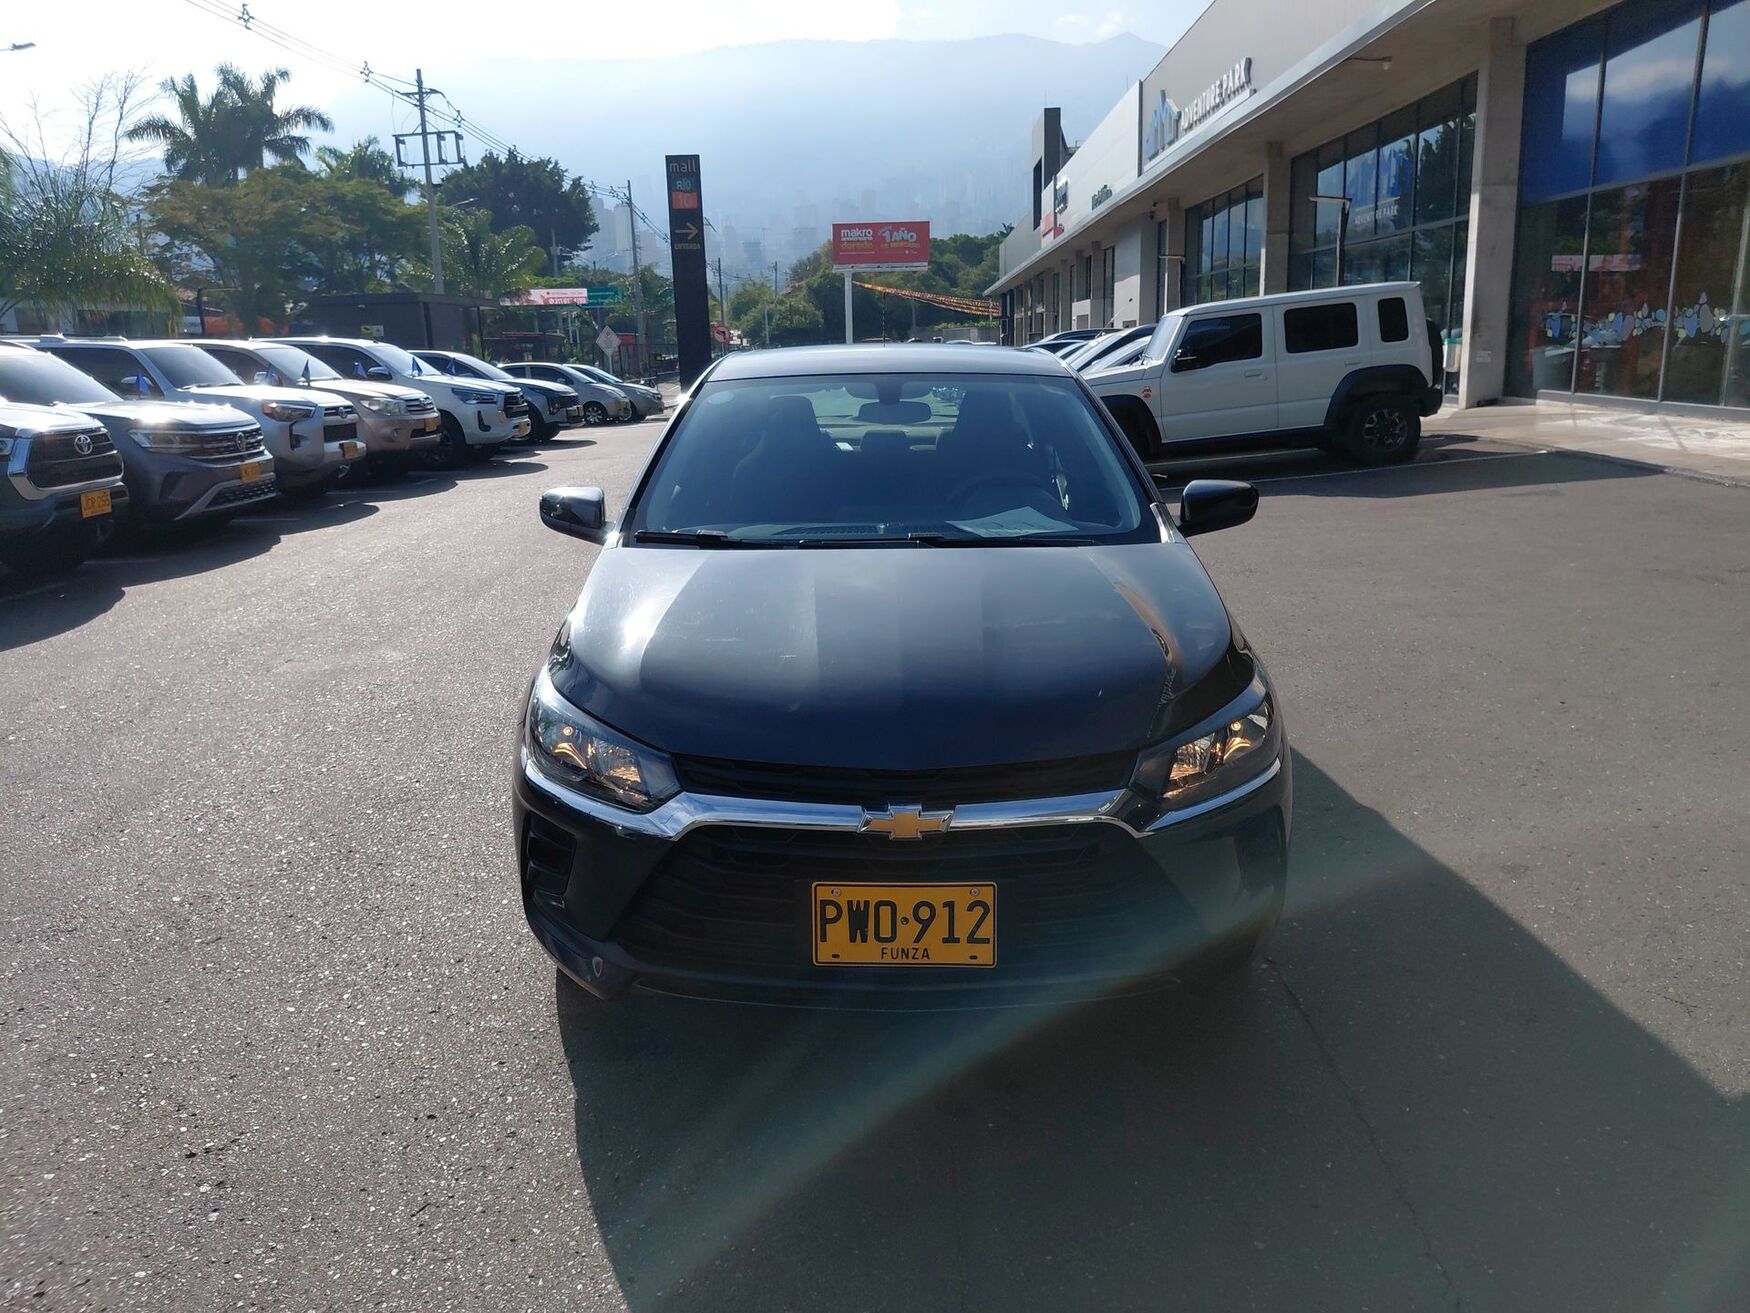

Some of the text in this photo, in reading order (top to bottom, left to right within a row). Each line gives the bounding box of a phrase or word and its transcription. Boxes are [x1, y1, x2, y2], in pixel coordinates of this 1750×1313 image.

[1179, 57, 1252, 130] ADVENTURE PARK
[669, 159, 697, 173] mall
[841, 228, 873, 237] makro
[891, 227, 917, 242] AÑO
[881, 947, 930, 960] FUNZA
